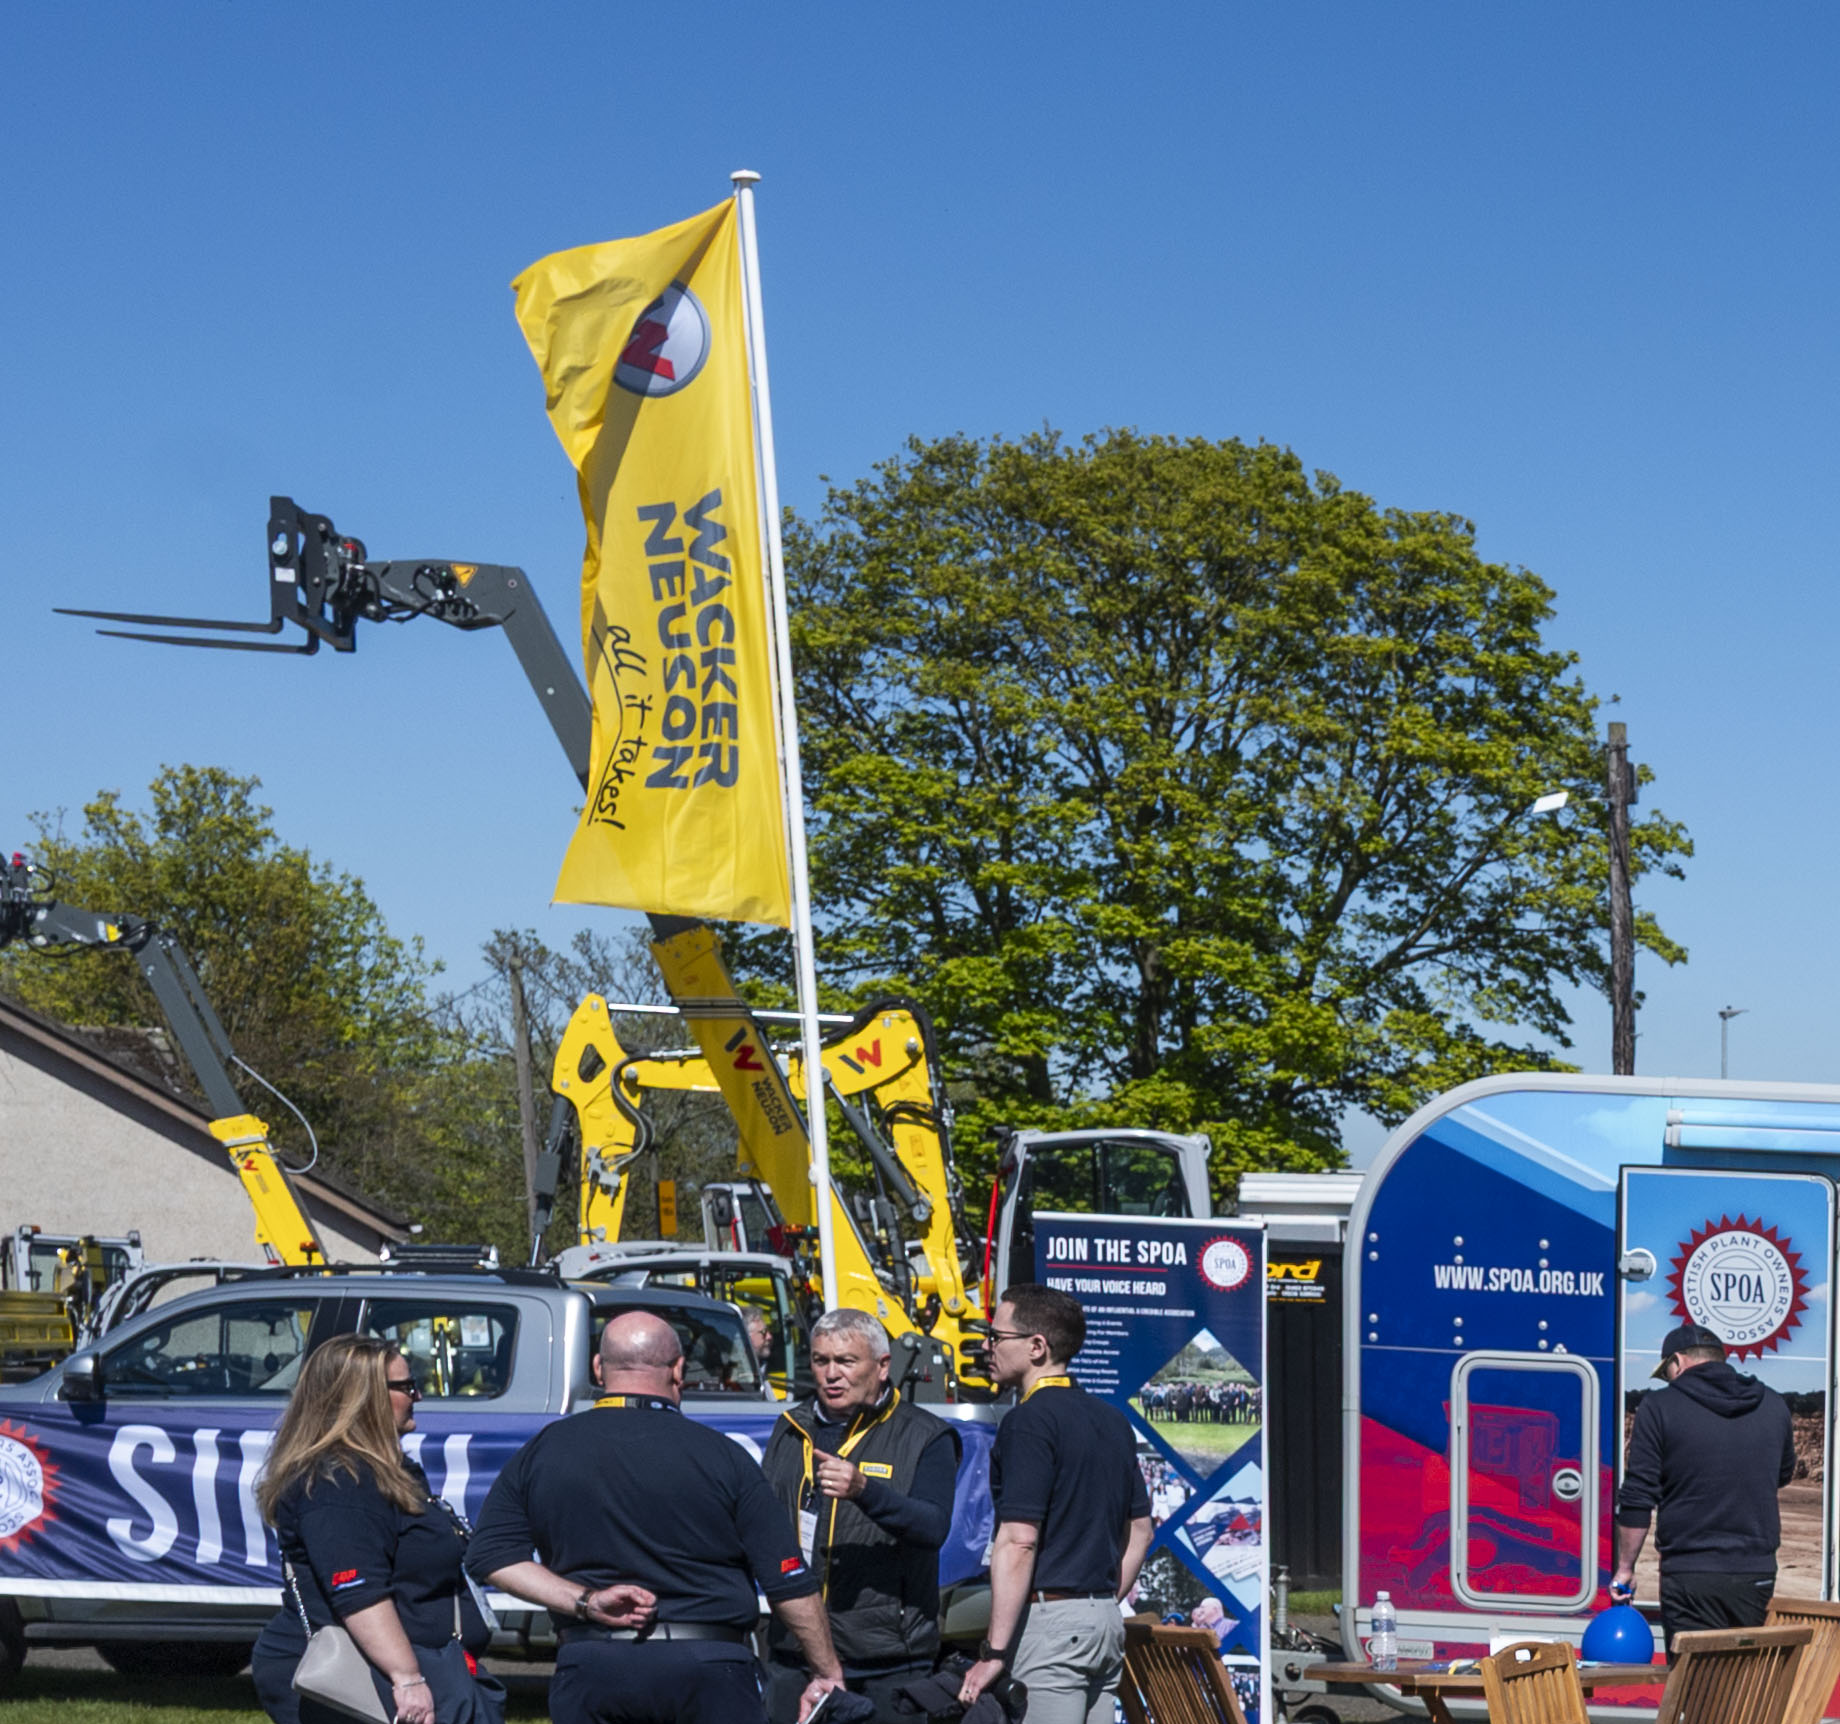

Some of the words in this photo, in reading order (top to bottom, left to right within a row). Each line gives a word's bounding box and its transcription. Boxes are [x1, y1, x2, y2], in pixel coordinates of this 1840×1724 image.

[607, 625, 647, 677] all
[637, 501, 697, 790] NEUSON
[684, 488, 738, 789] WACKER
[625, 694, 653, 729] it
[599, 736, 648, 830] takes!
[1046, 1237, 1088, 1262] JOIN
[1094, 1239, 1131, 1263] THE
[1137, 1241, 1187, 1266] SPOA
[1046, 1277, 1073, 1293] HAVE
[1075, 1279, 1100, 1294] YOUR
[1102, 1280, 1130, 1295] VOICE
[1133, 1281, 1166, 1296] HEARD
[1434, 1264, 1604, 1296] WWW.SPOA.ORG.UK
[1687, 1251, 1709, 1325] SCOTTISH
[1710, 1235, 1761, 1252] PLANT
[1764, 1248, 1790, 1316] OWNERS
[1710, 1272, 1766, 1304] SPOA
